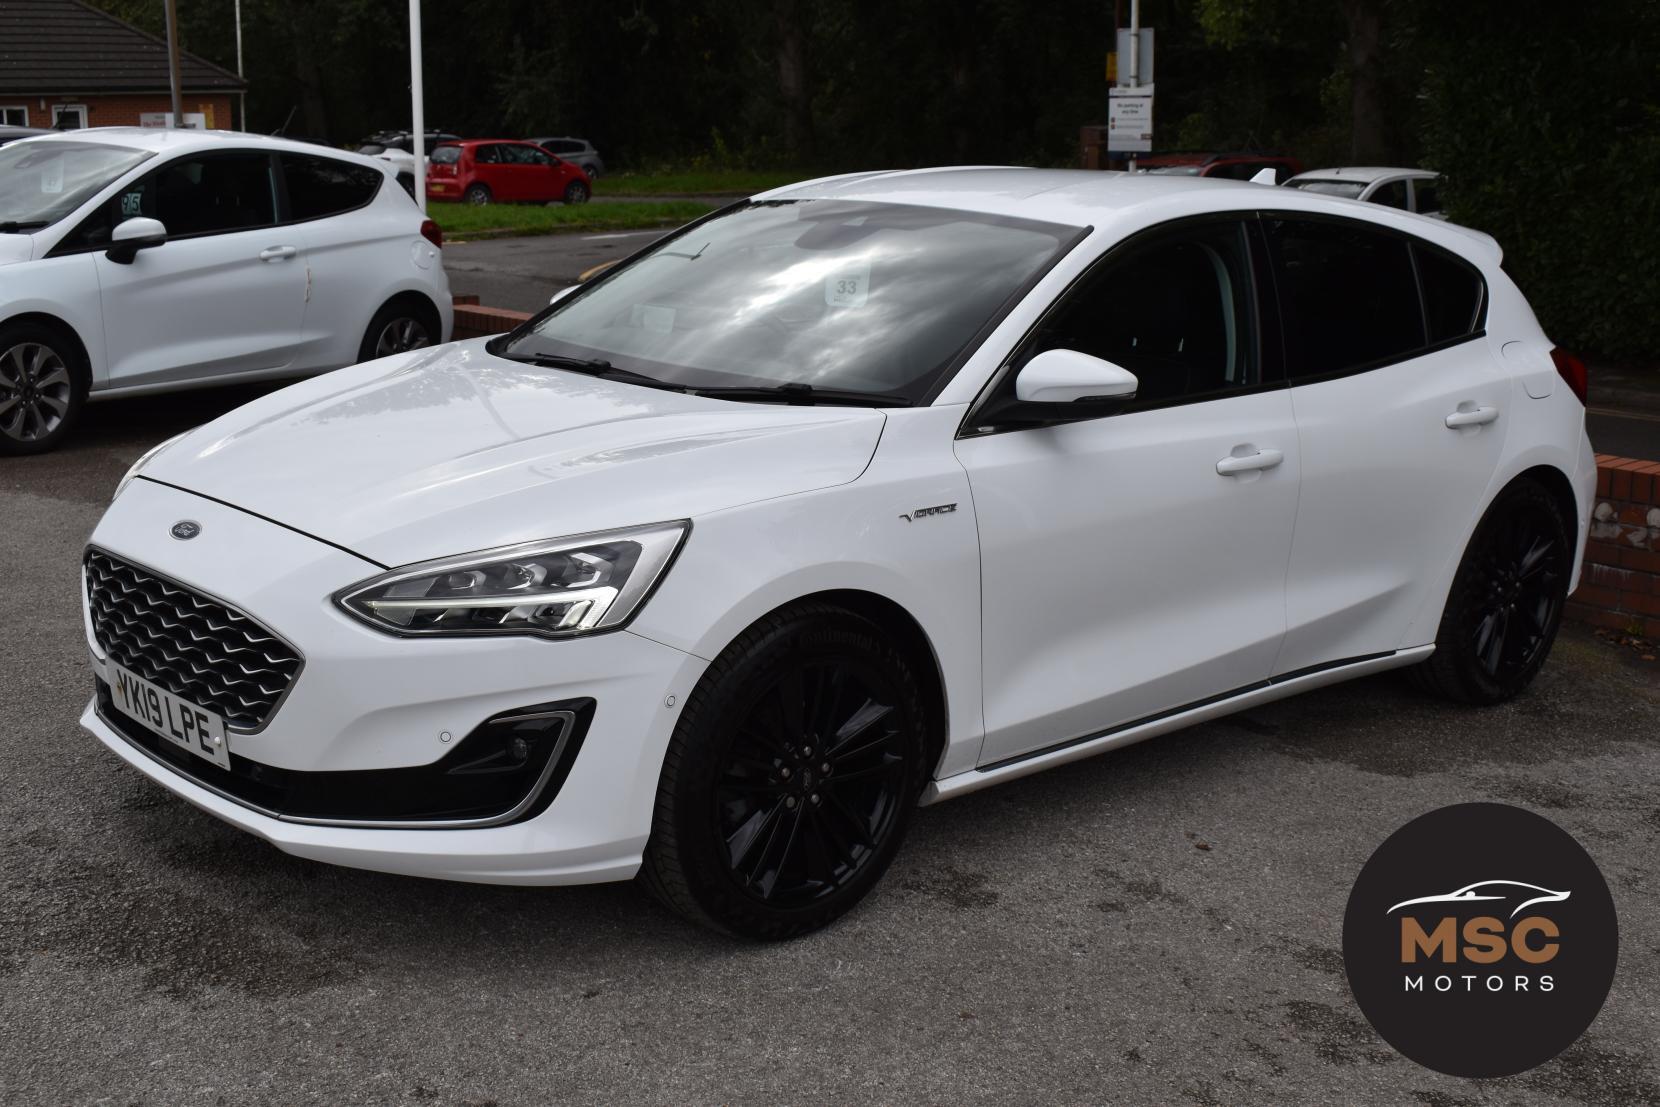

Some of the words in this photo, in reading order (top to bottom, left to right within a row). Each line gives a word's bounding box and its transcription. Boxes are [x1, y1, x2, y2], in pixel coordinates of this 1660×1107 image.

[122, 195, 139, 212] 95
[837, 280, 857, 295] 33
[117, 669, 163, 728] YK19
[165, 696, 214, 756] LPE
